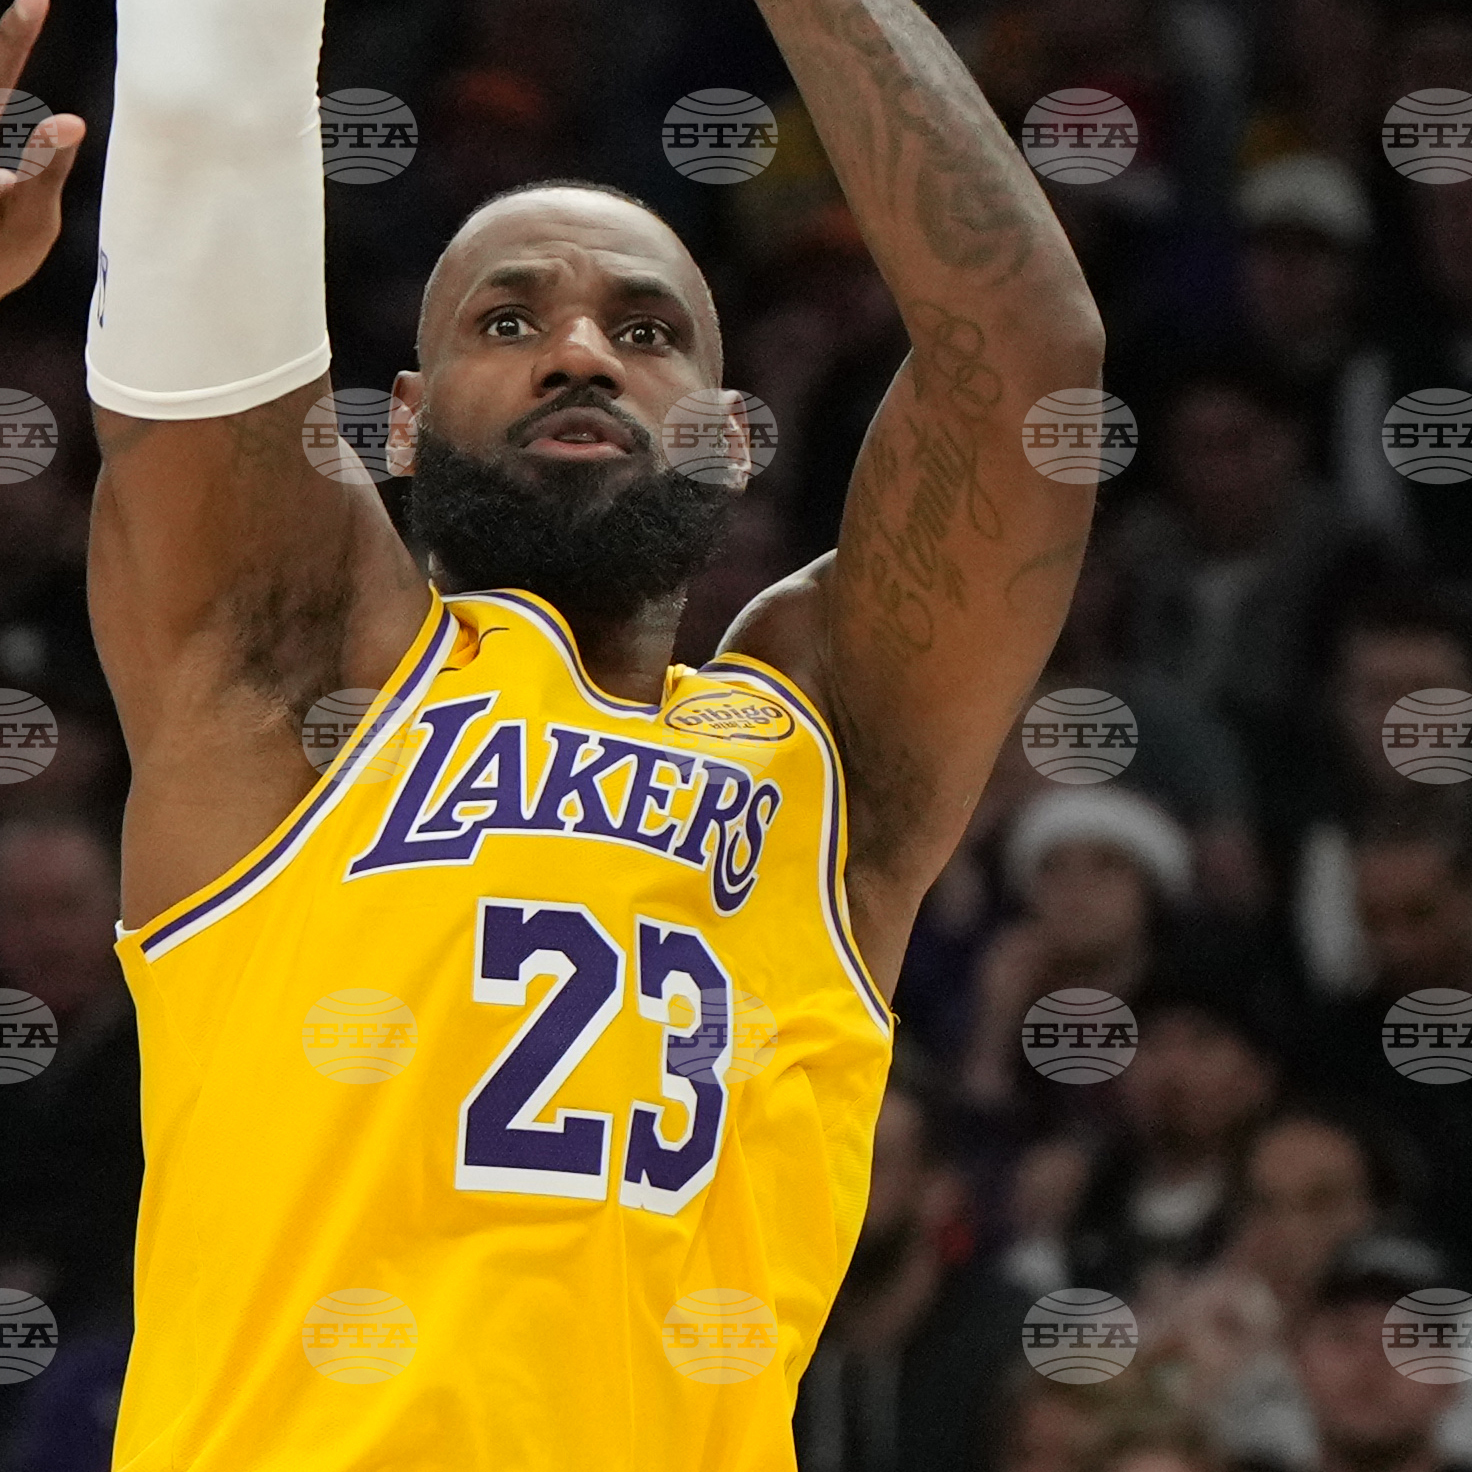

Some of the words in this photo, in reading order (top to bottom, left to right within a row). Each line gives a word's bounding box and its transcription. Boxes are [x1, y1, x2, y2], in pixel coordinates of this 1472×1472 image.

[342, 690, 783, 918] LAKERS
[674, 704, 783, 725] bibigo
[454, 896, 732, 1216] 23
